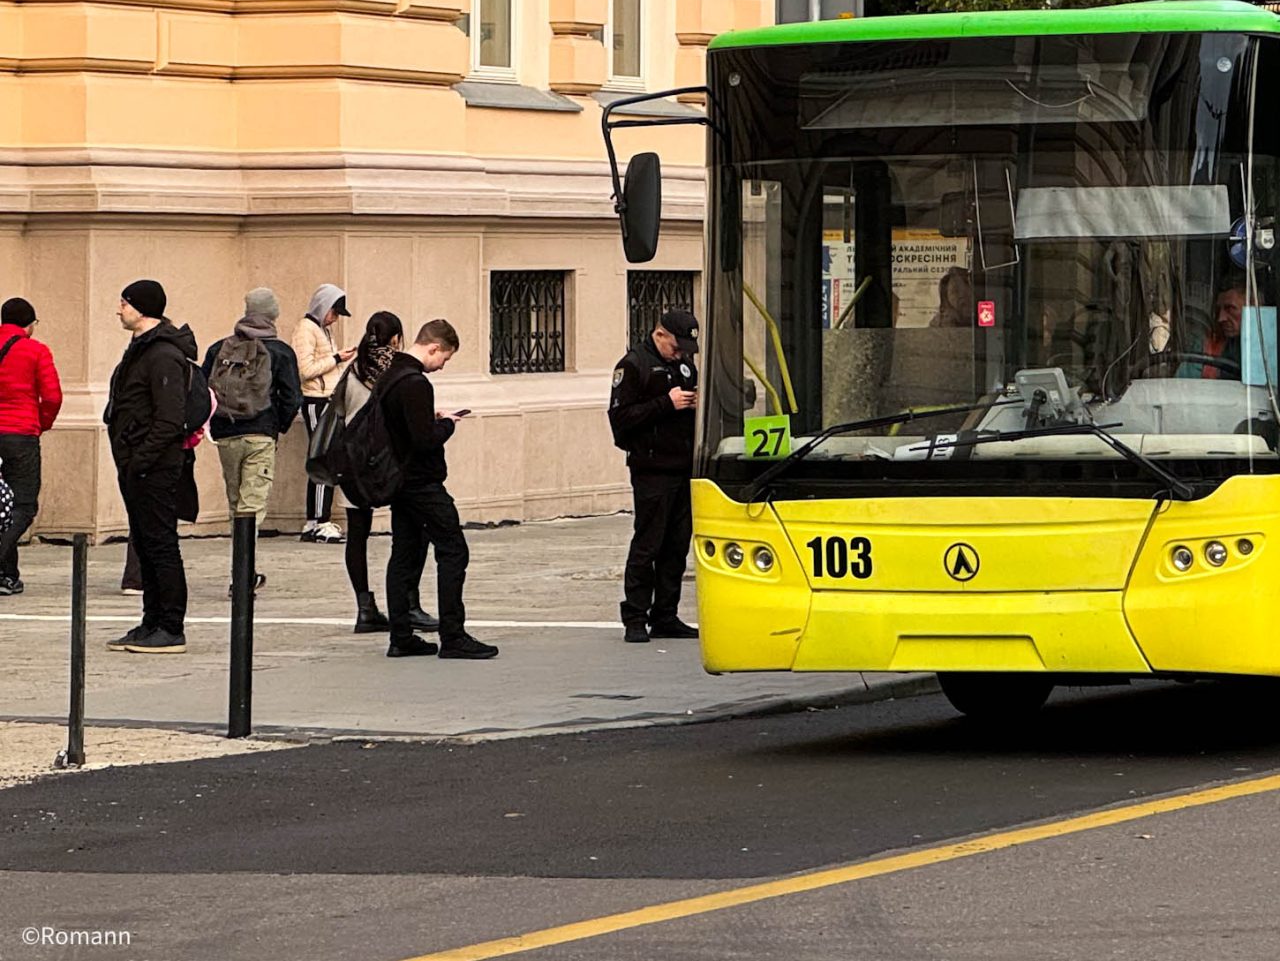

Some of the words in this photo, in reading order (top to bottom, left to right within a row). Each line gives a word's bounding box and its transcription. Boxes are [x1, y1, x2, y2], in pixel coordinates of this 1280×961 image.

[899, 244, 957, 252] АКАДЕМІЧНИЙ
[889, 254, 957, 263] ОСКРЕСІННЯ
[752, 427, 786, 457] 27
[806, 536, 873, 579] 103
